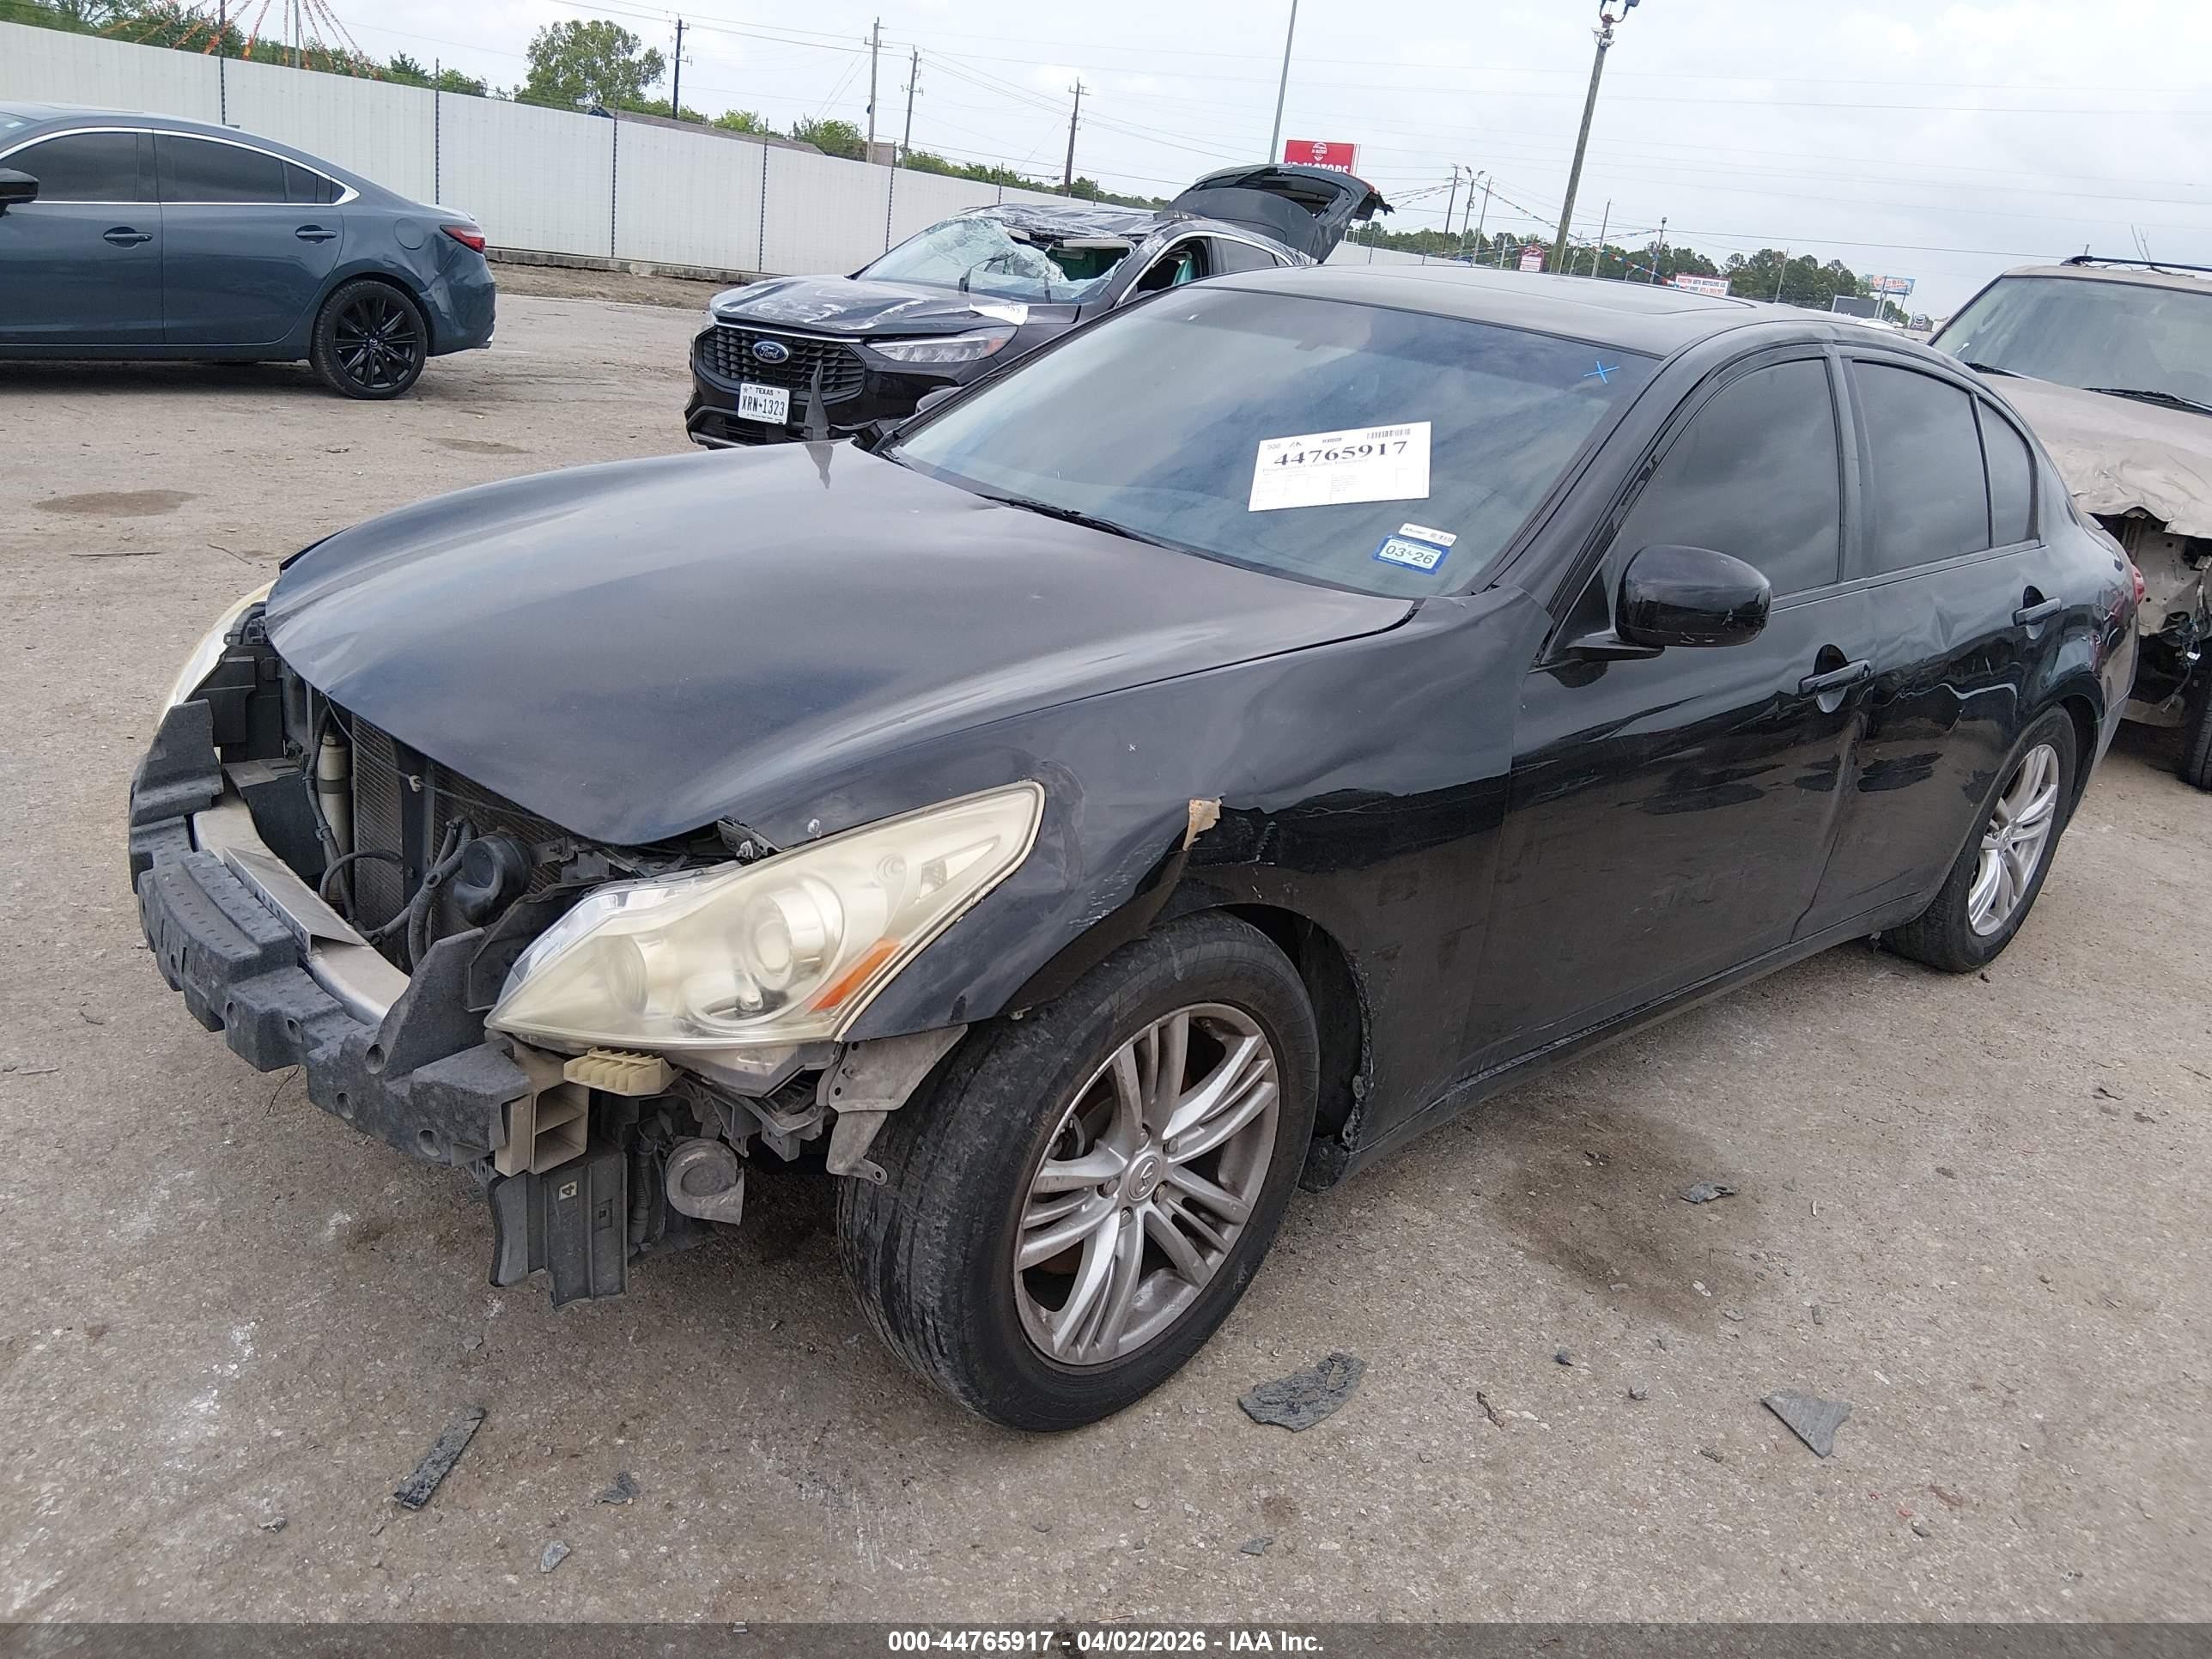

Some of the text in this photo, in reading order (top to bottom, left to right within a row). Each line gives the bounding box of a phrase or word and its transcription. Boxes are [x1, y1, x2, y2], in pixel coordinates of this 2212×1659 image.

[759, 345, 780, 359] Ford
[756, 387, 774, 396] TEXAS
[1273, 441, 1407, 466] 44765917
